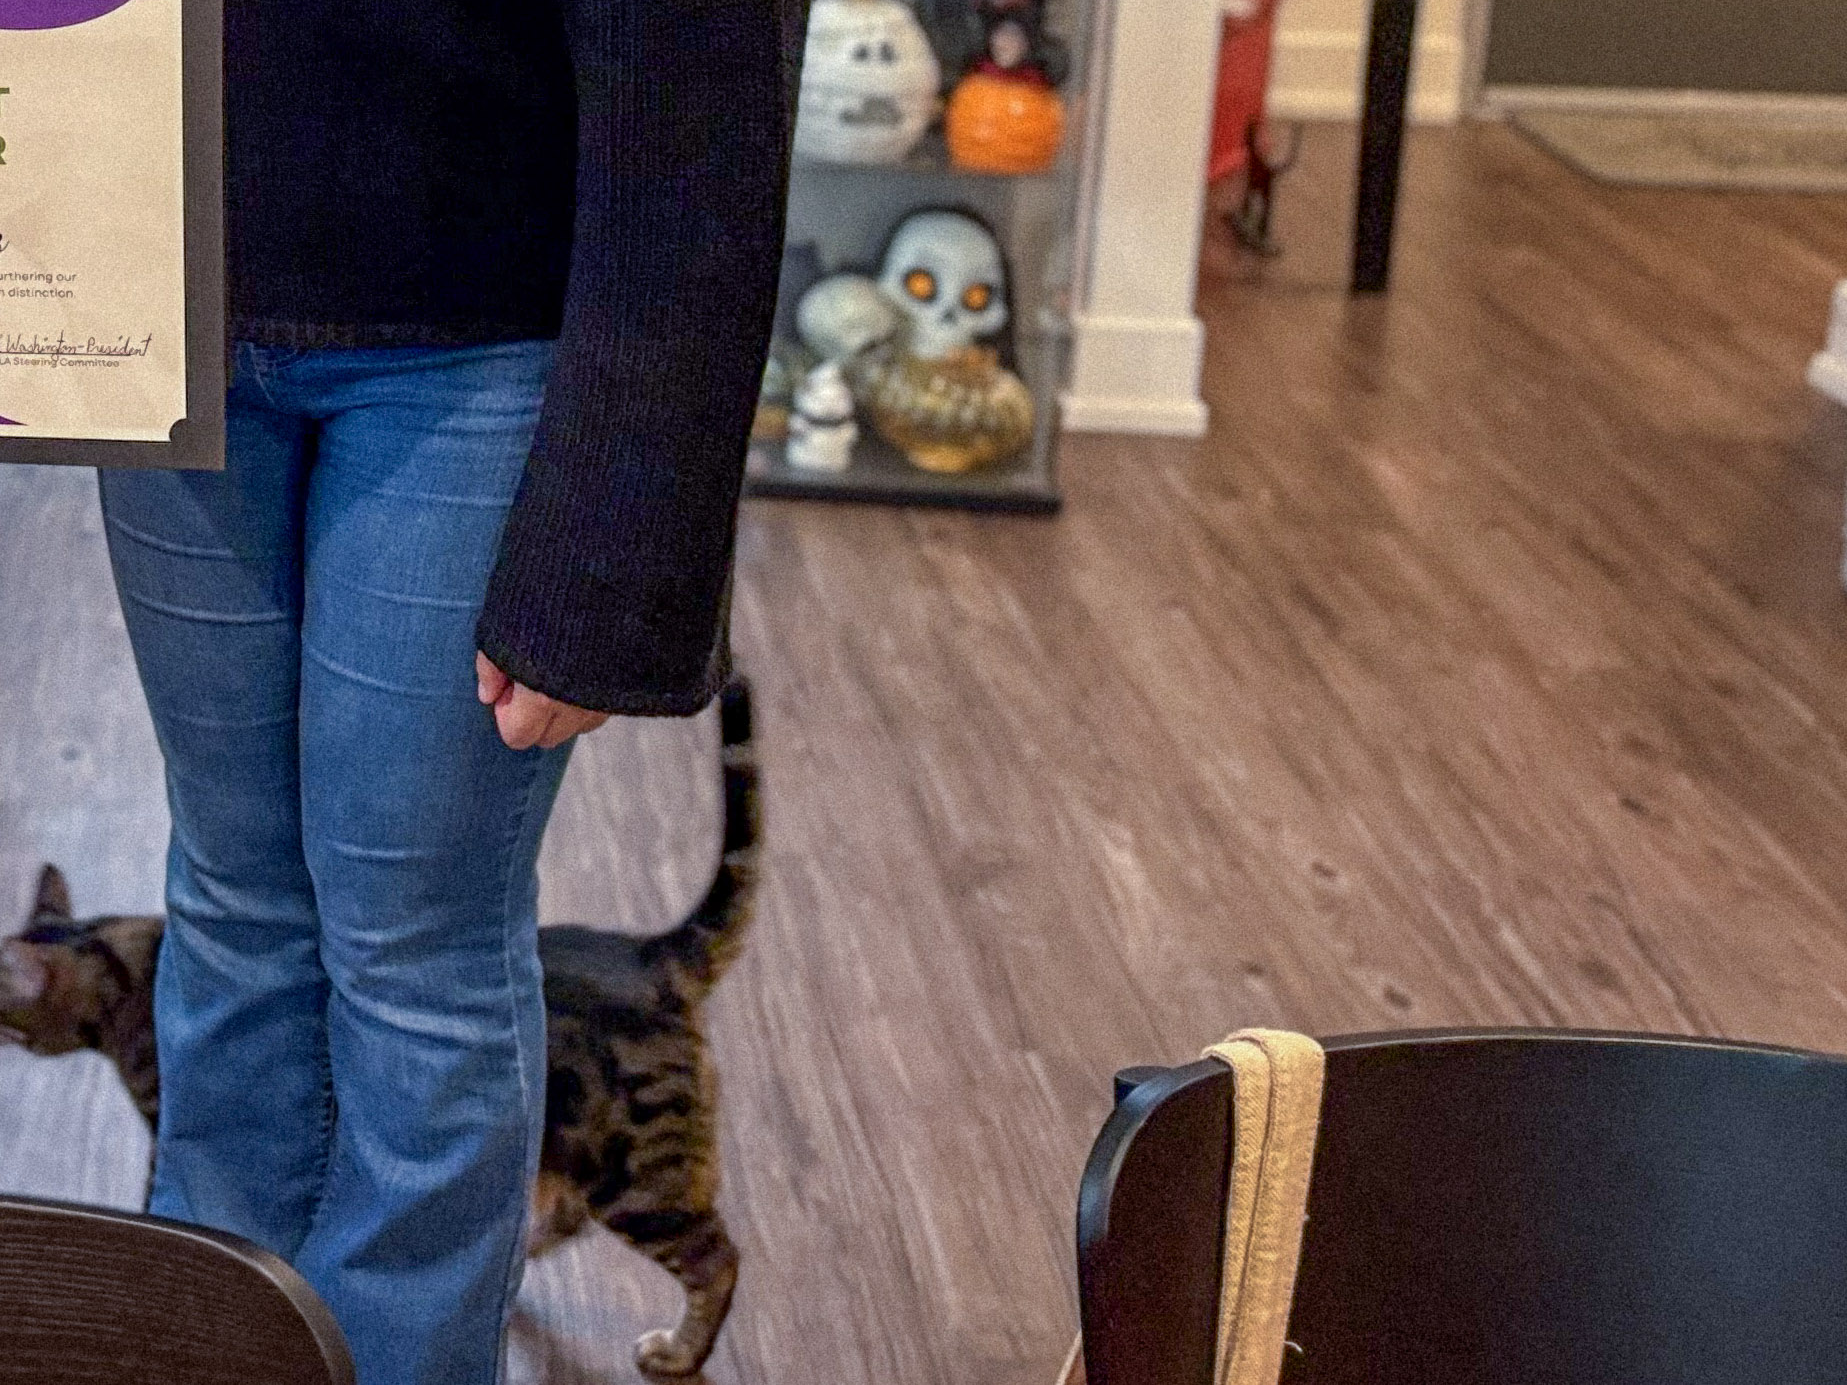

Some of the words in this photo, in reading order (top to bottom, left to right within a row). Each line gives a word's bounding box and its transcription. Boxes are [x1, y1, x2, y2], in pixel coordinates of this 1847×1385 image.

[55, 274, 77, 282] our
[13, 357, 57, 367] Steering
[59, 358, 120, 368] Committee
